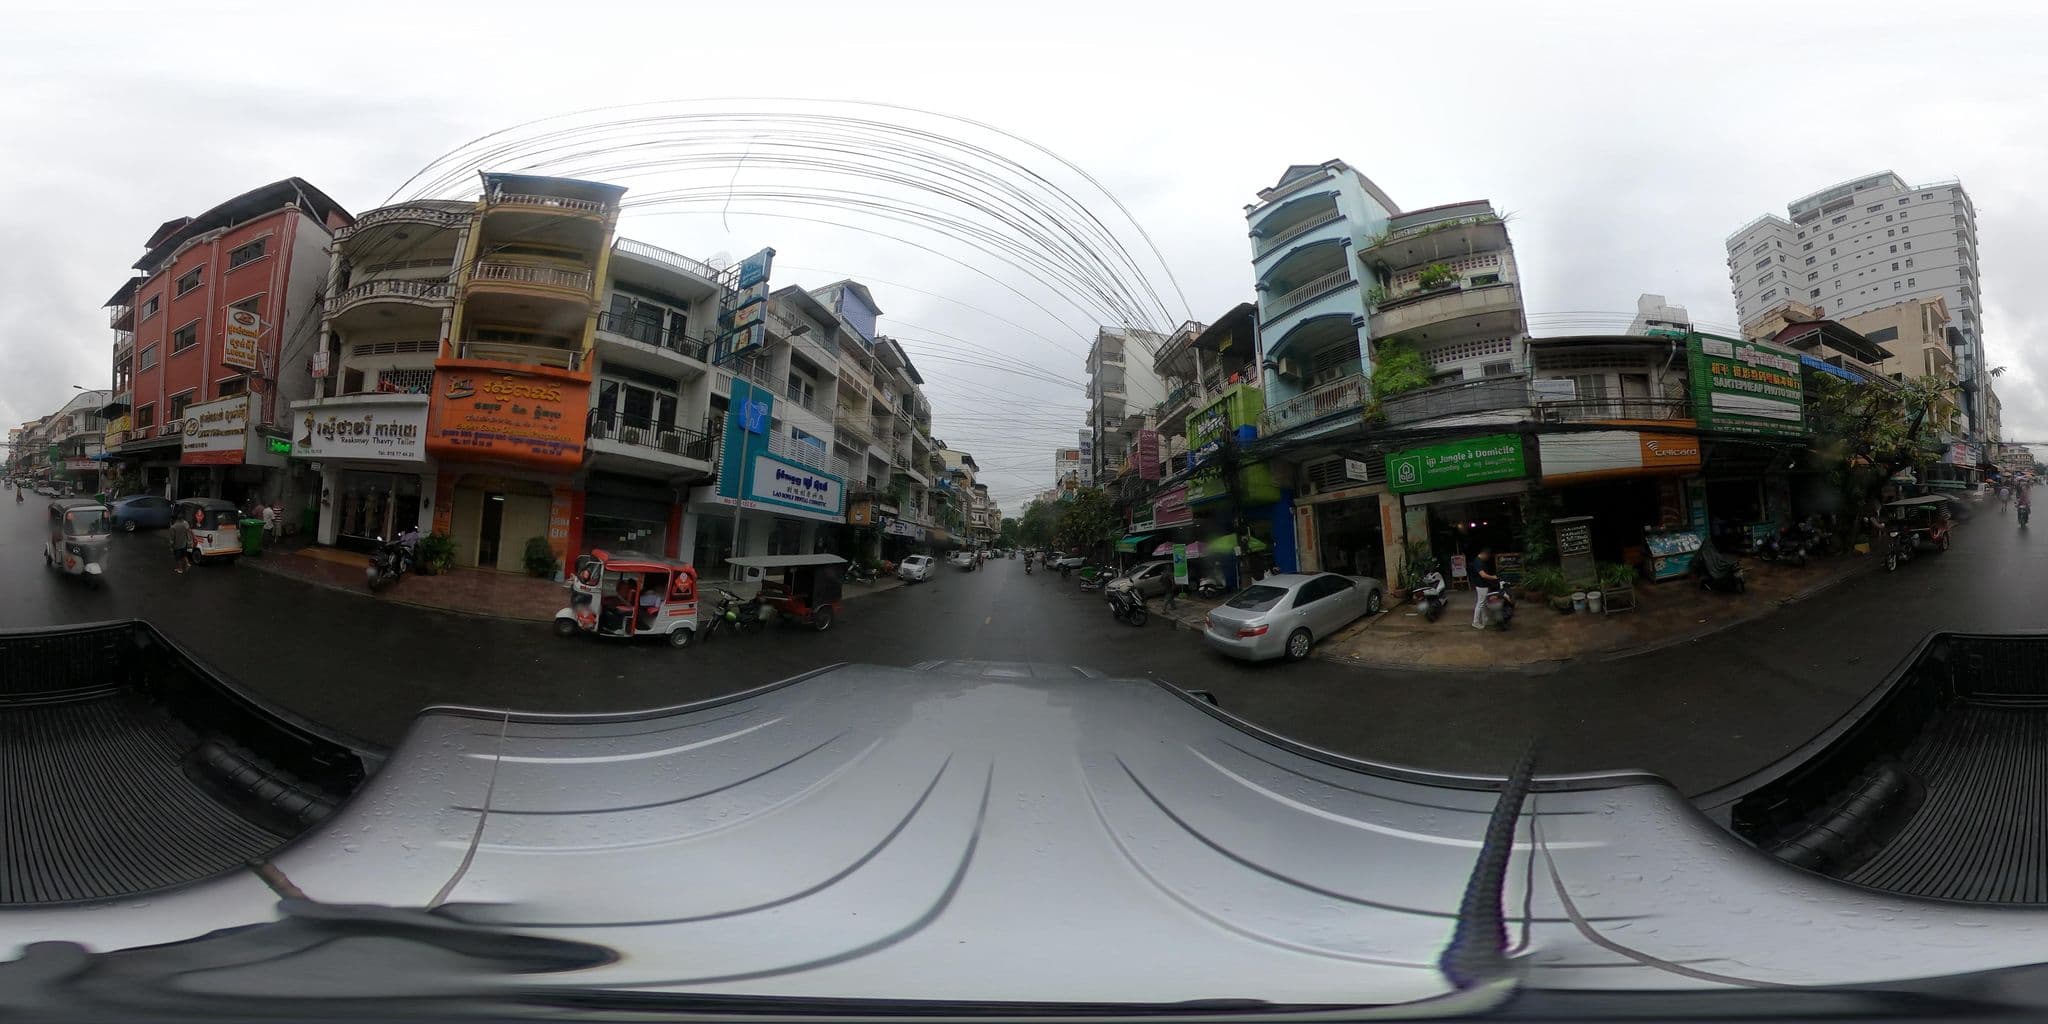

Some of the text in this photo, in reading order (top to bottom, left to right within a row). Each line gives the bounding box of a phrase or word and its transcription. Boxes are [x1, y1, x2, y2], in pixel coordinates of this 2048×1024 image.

[1763, 385, 1785, 396] PHOTO
[1440, 445, 1515, 464] Jungle à Domicile
